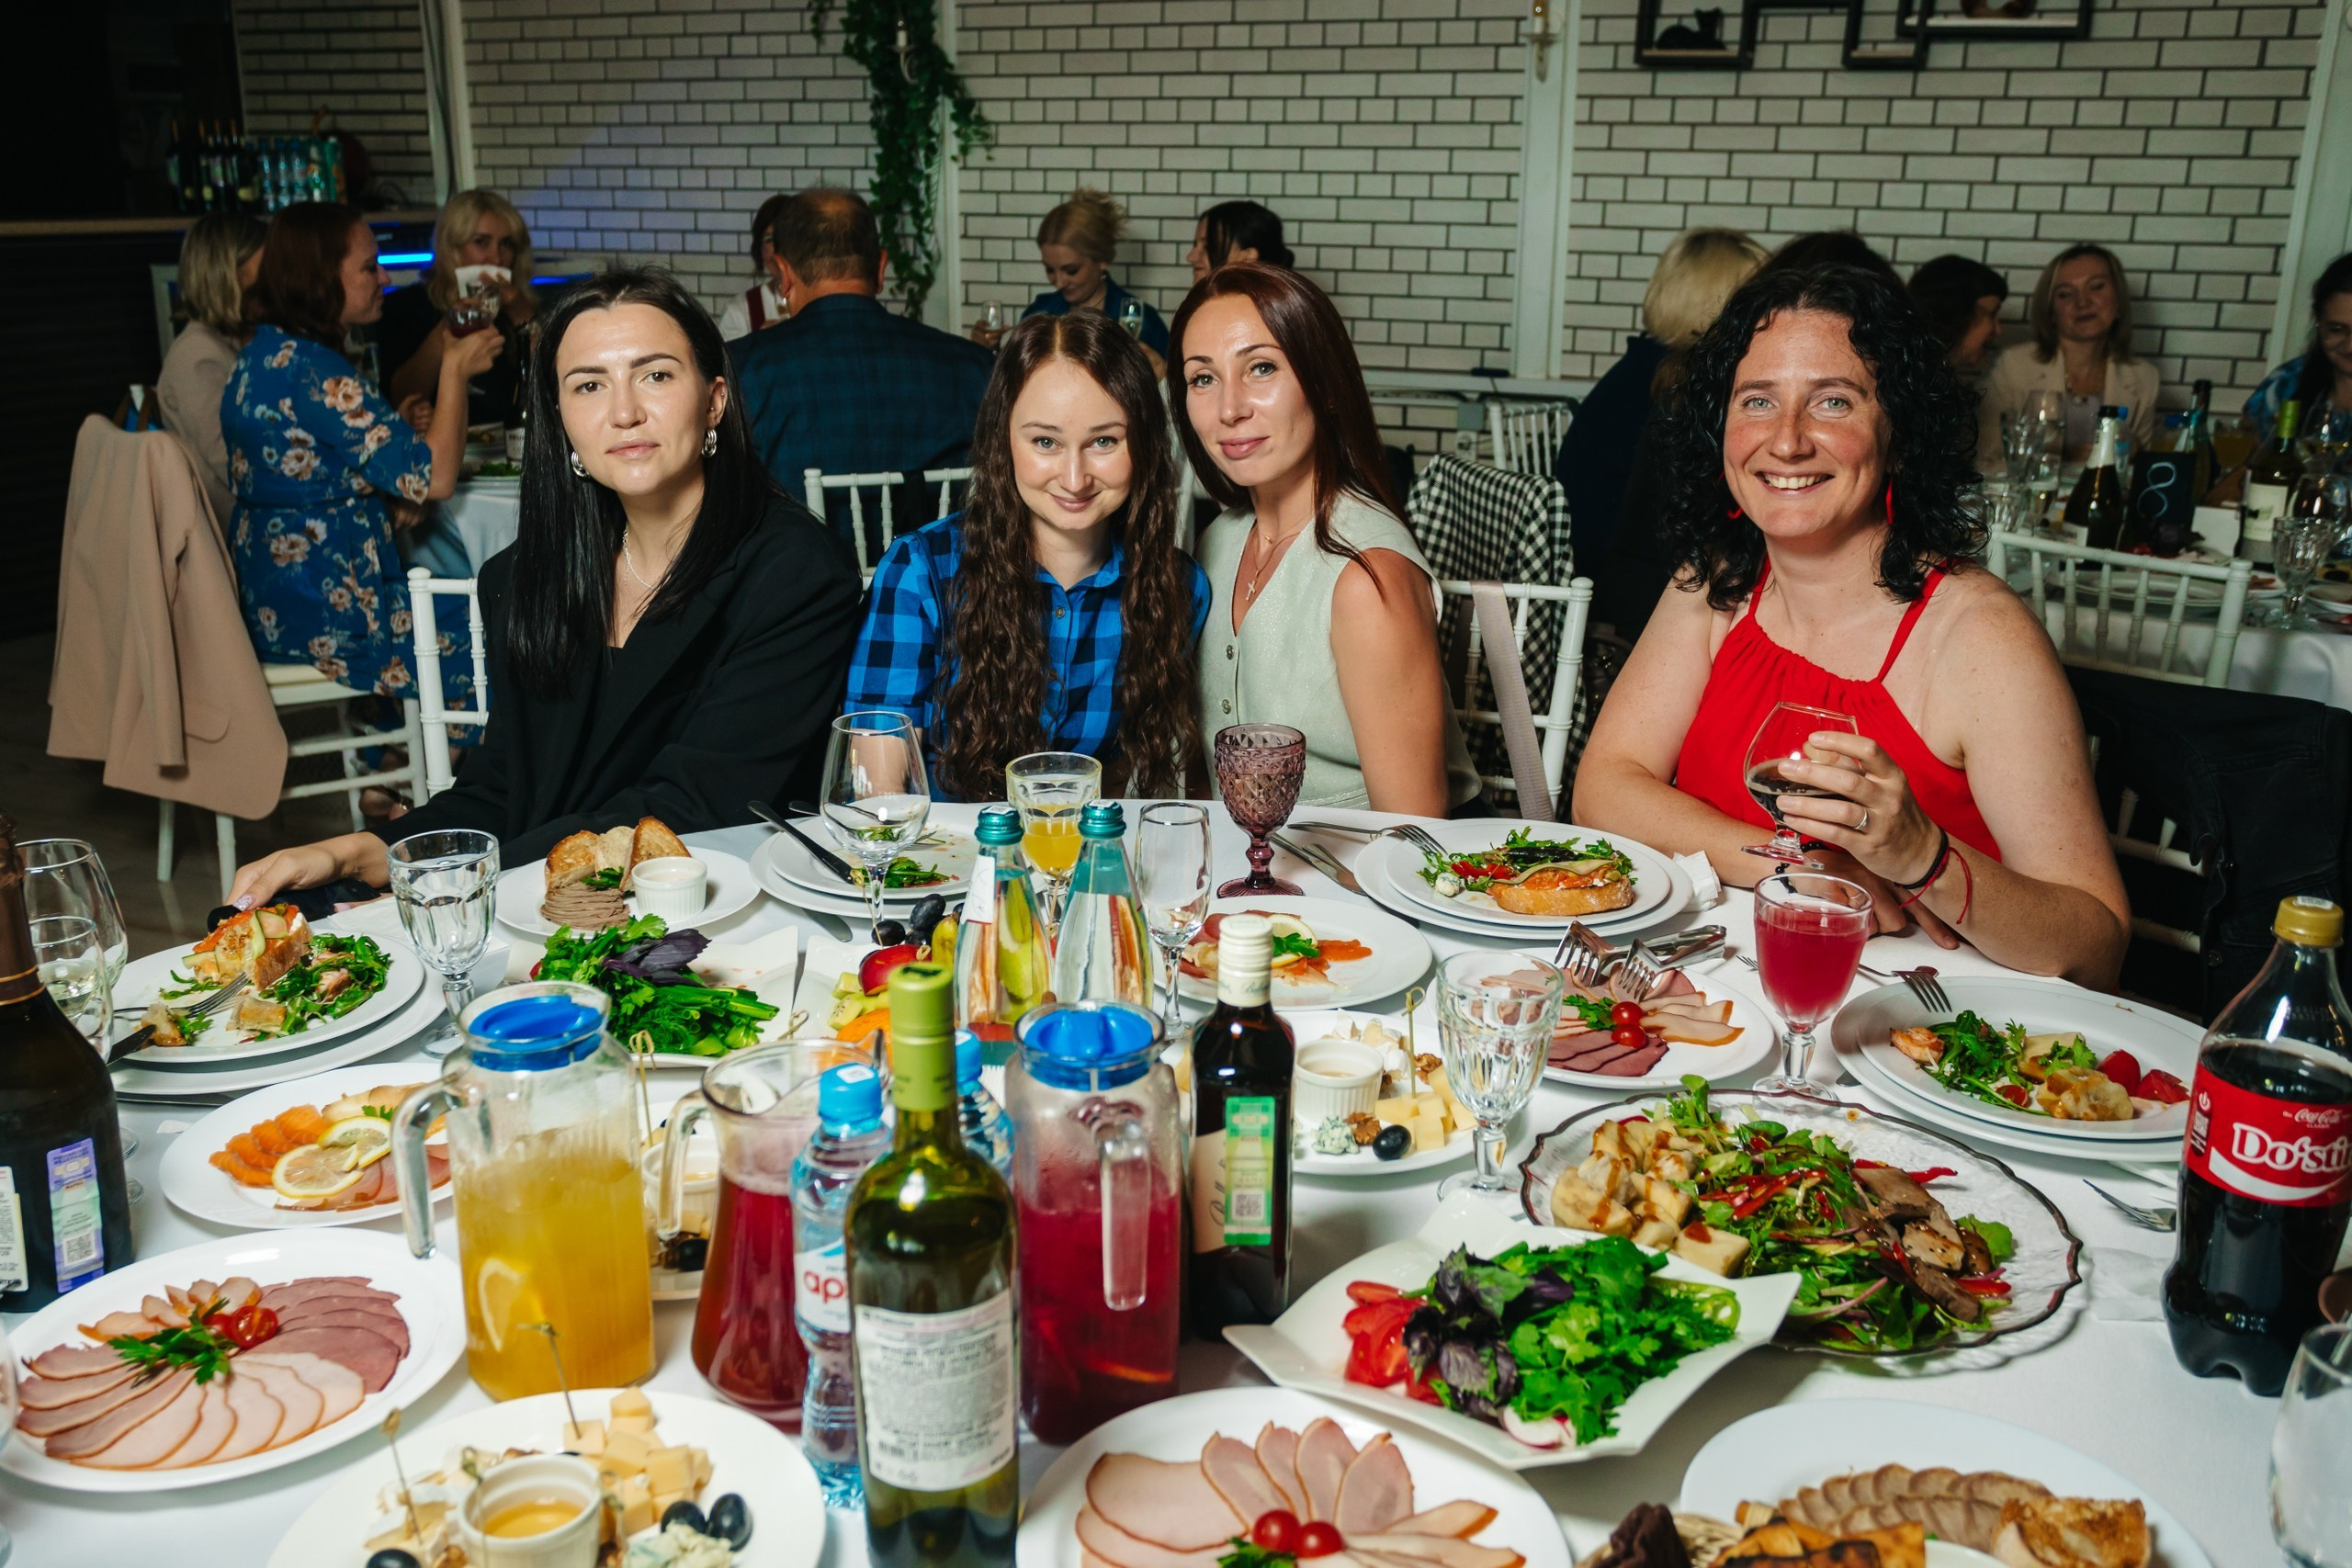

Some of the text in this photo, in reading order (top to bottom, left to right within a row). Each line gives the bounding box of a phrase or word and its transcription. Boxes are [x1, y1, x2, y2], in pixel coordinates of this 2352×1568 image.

[2137, 461, 2177, 518] 8
[2232, 1122, 2352, 1173] Do‘sti
[804, 1270, 845, 1303] ap
